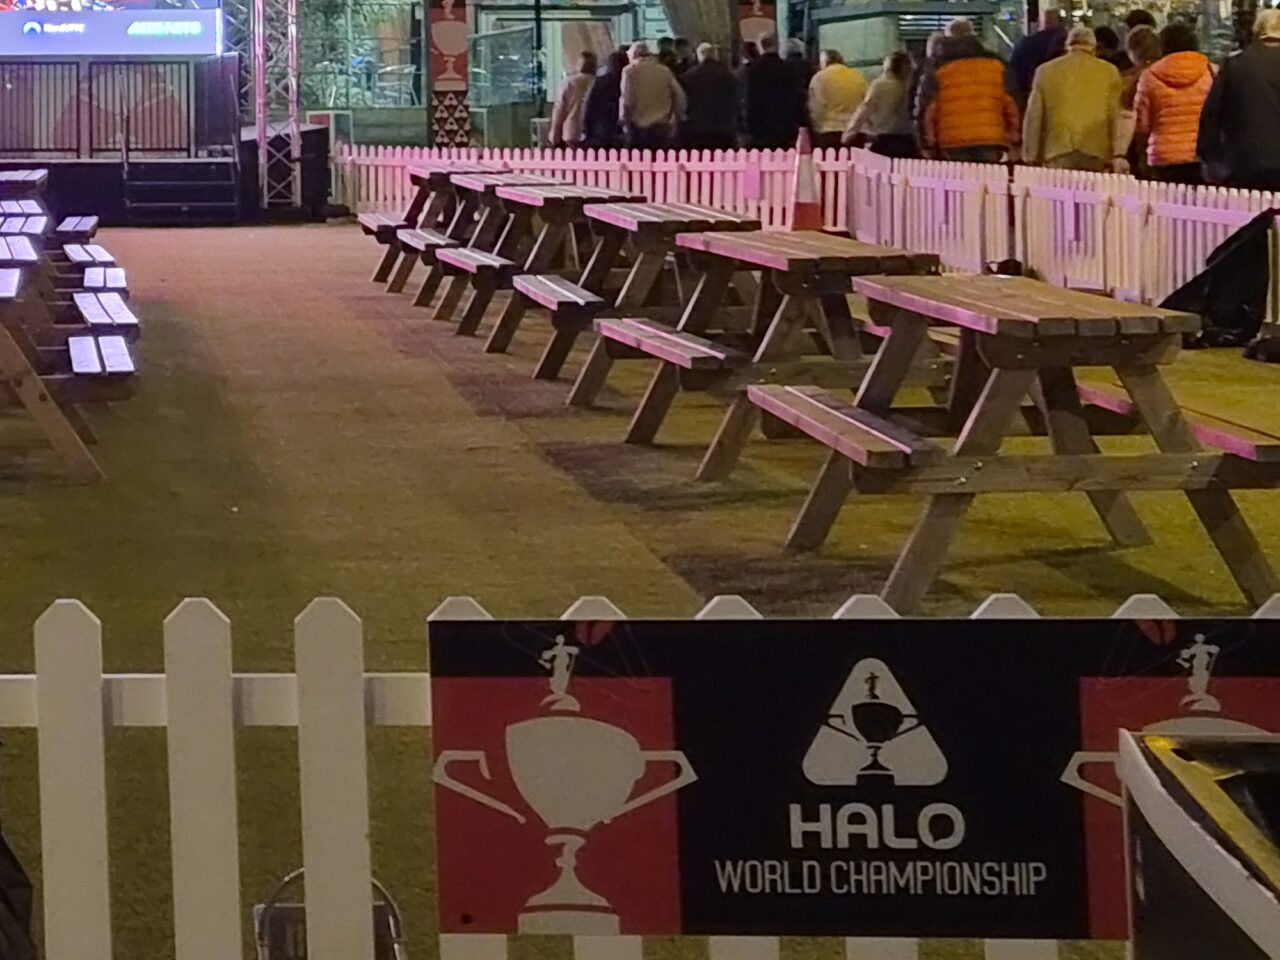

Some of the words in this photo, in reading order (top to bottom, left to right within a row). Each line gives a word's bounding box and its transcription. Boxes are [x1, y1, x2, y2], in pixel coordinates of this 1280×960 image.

[788, 802, 966, 850] HALO
[713, 859, 821, 894] WORLD
[830, 859, 1048, 897] CHAMPIONSHIP
